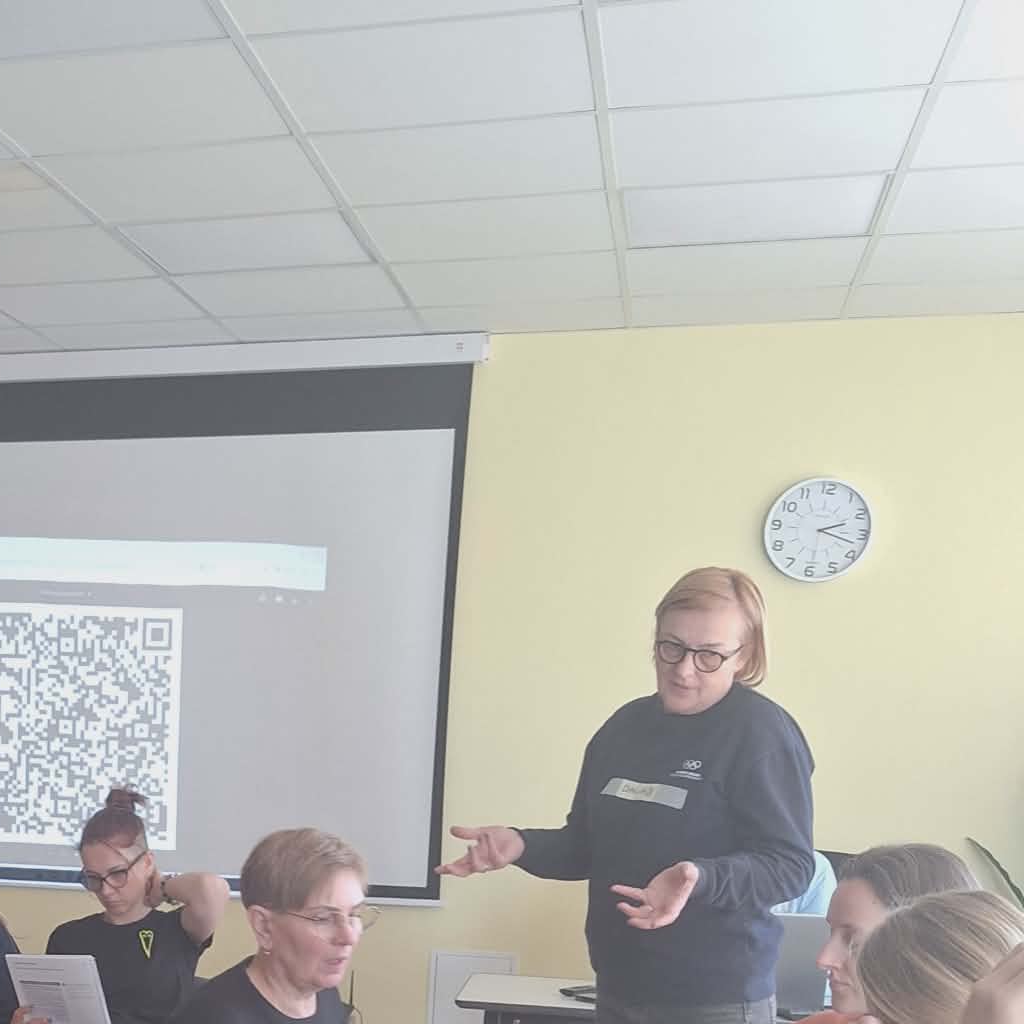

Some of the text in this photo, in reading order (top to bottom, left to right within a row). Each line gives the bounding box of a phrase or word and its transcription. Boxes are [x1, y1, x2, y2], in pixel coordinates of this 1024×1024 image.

[800, 488, 810, 499] 11
[821, 483, 837, 495] 12
[848, 492, 854, 504] 1
[782, 501, 797, 512] 10
[855, 509, 865, 520] 2
[771, 520, 782, 531] 9
[856, 529, 869, 541] 3
[772, 540, 784, 551] 8
[844, 550, 856, 561] 4
[785, 557, 795, 568] 7
[827, 562, 839, 573] 5
[804, 566, 815, 577] 6
